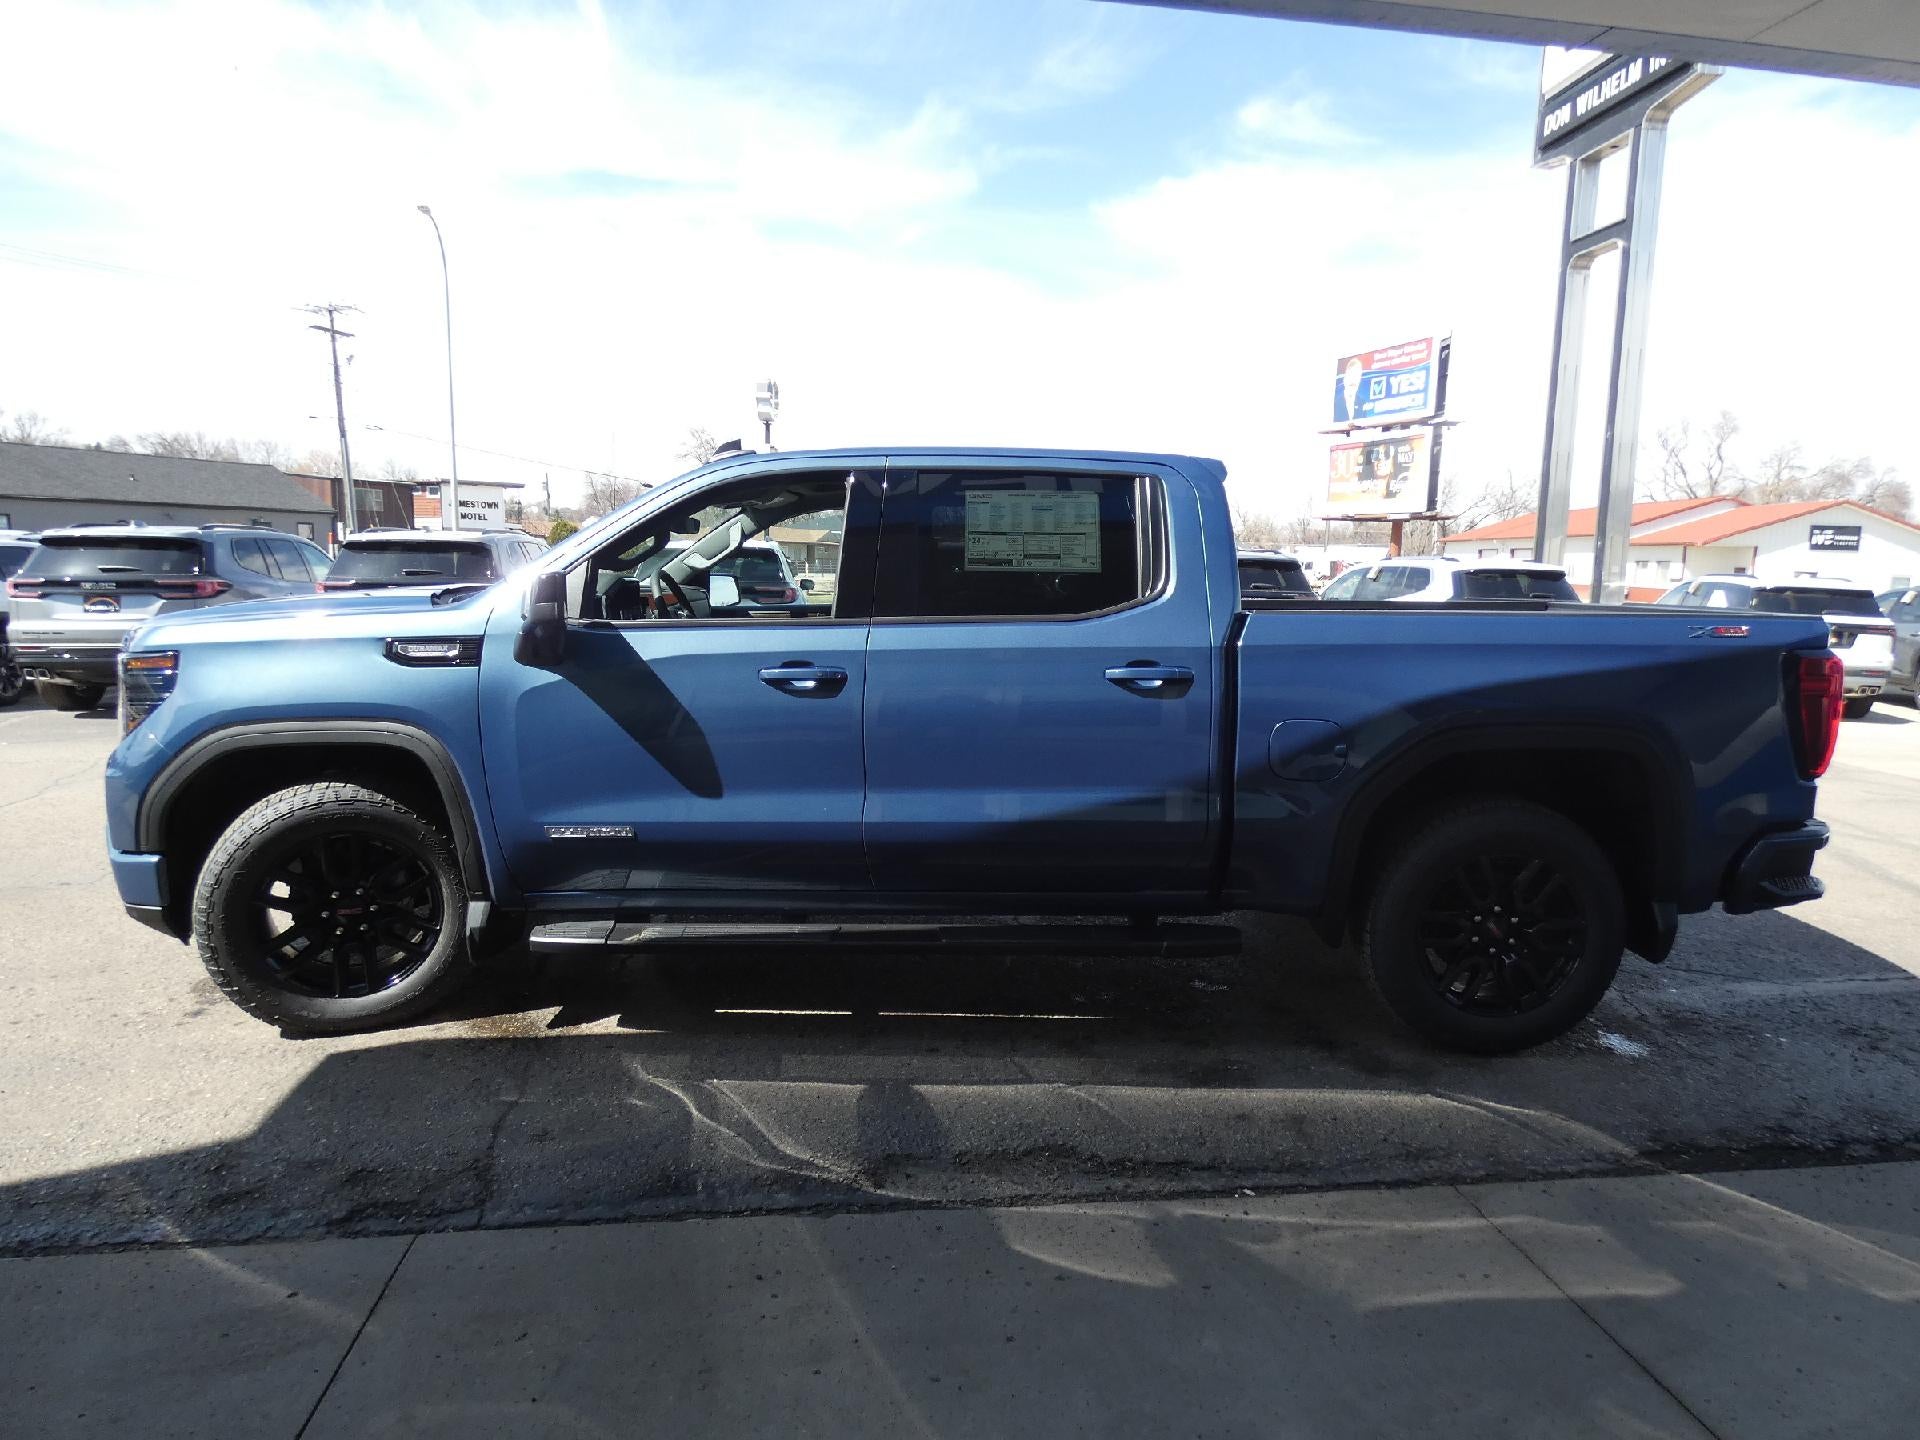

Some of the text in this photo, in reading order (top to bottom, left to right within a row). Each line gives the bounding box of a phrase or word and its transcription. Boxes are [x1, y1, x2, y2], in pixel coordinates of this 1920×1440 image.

[1543, 102, 1572, 137] DON
[1576, 57, 1643, 117] WILHELM
[458, 500, 499, 510] MESTOWN
[460, 512, 488, 521] MOTEL
